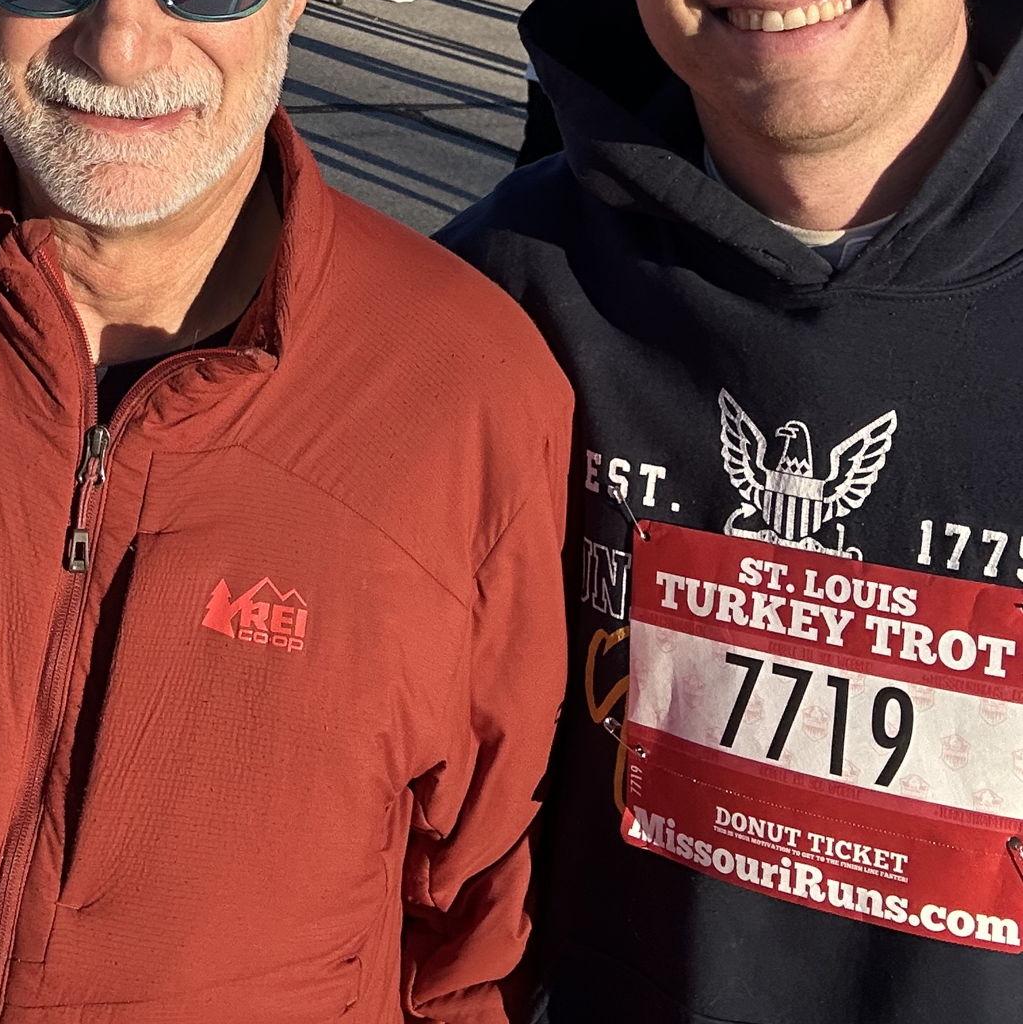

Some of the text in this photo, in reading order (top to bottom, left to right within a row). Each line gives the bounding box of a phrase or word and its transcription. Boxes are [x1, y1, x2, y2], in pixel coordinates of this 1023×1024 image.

[585, 449, 680, 512] EST.
[738, 556, 918, 617] ST. LOUIS
[240, 601, 308, 638] REI
[656, 570, 855, 647] TURKEY
[865, 614, 1016, 678] TROT
[719, 651, 914, 787] 7719
[630, 764, 643, 797] 7719
[715, 806, 909, 873] DONUT TICKET
[750, 837, 791, 854] MOTIVATION
[826, 857, 840, 866] THE
[628, 804, 1021, 947] MissouriRuns.com
